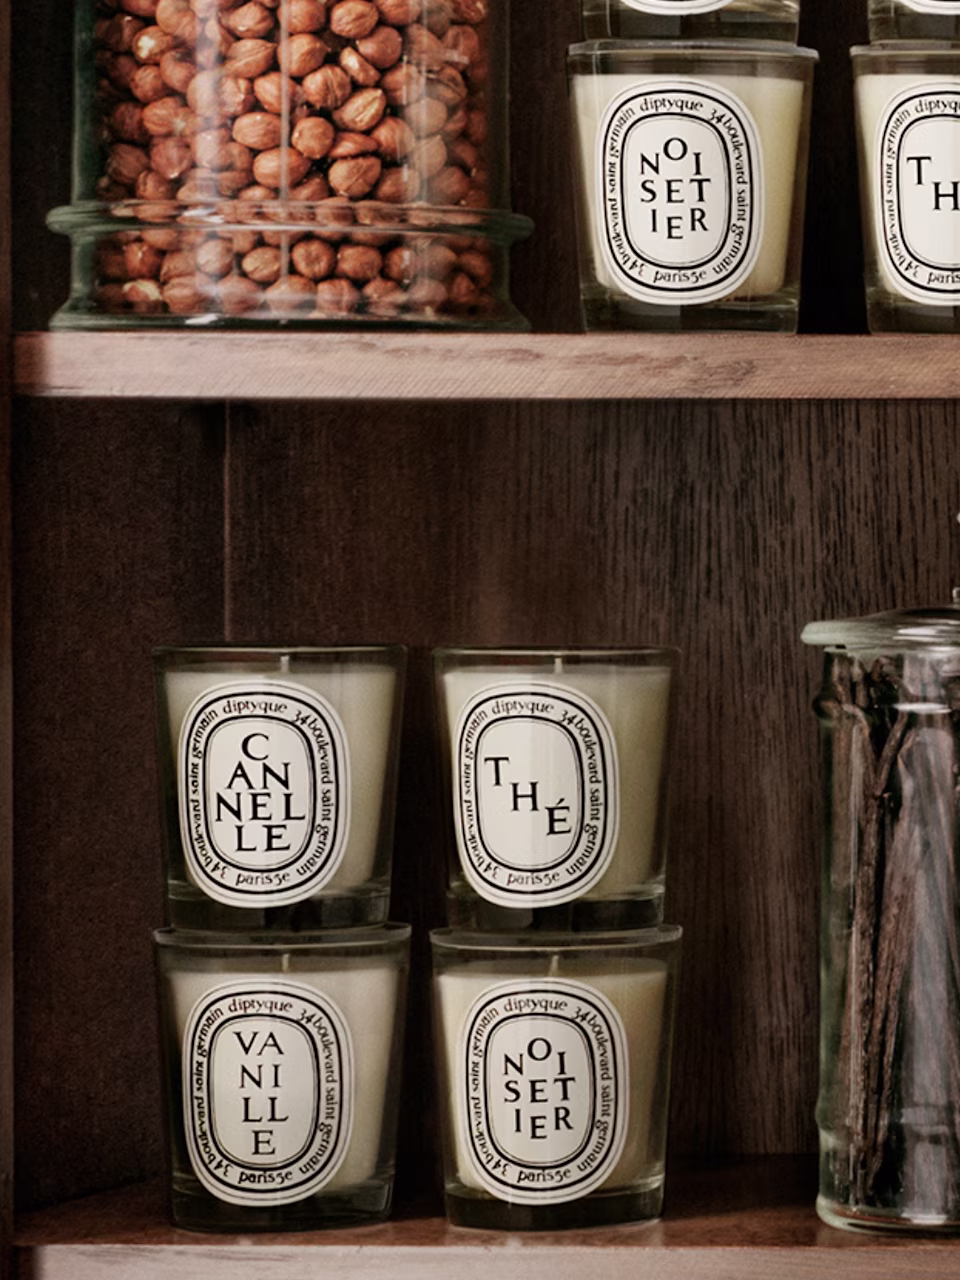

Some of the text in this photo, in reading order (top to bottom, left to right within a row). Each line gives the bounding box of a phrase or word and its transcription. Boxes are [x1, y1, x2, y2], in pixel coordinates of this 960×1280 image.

[640, 96, 703, 114] diptyque
[222, 699, 288, 717] diptyque
[491, 699, 555, 717] diptyque
[227, 997, 294, 1016] diptyque
[502, 997, 568, 1015] diptyque
